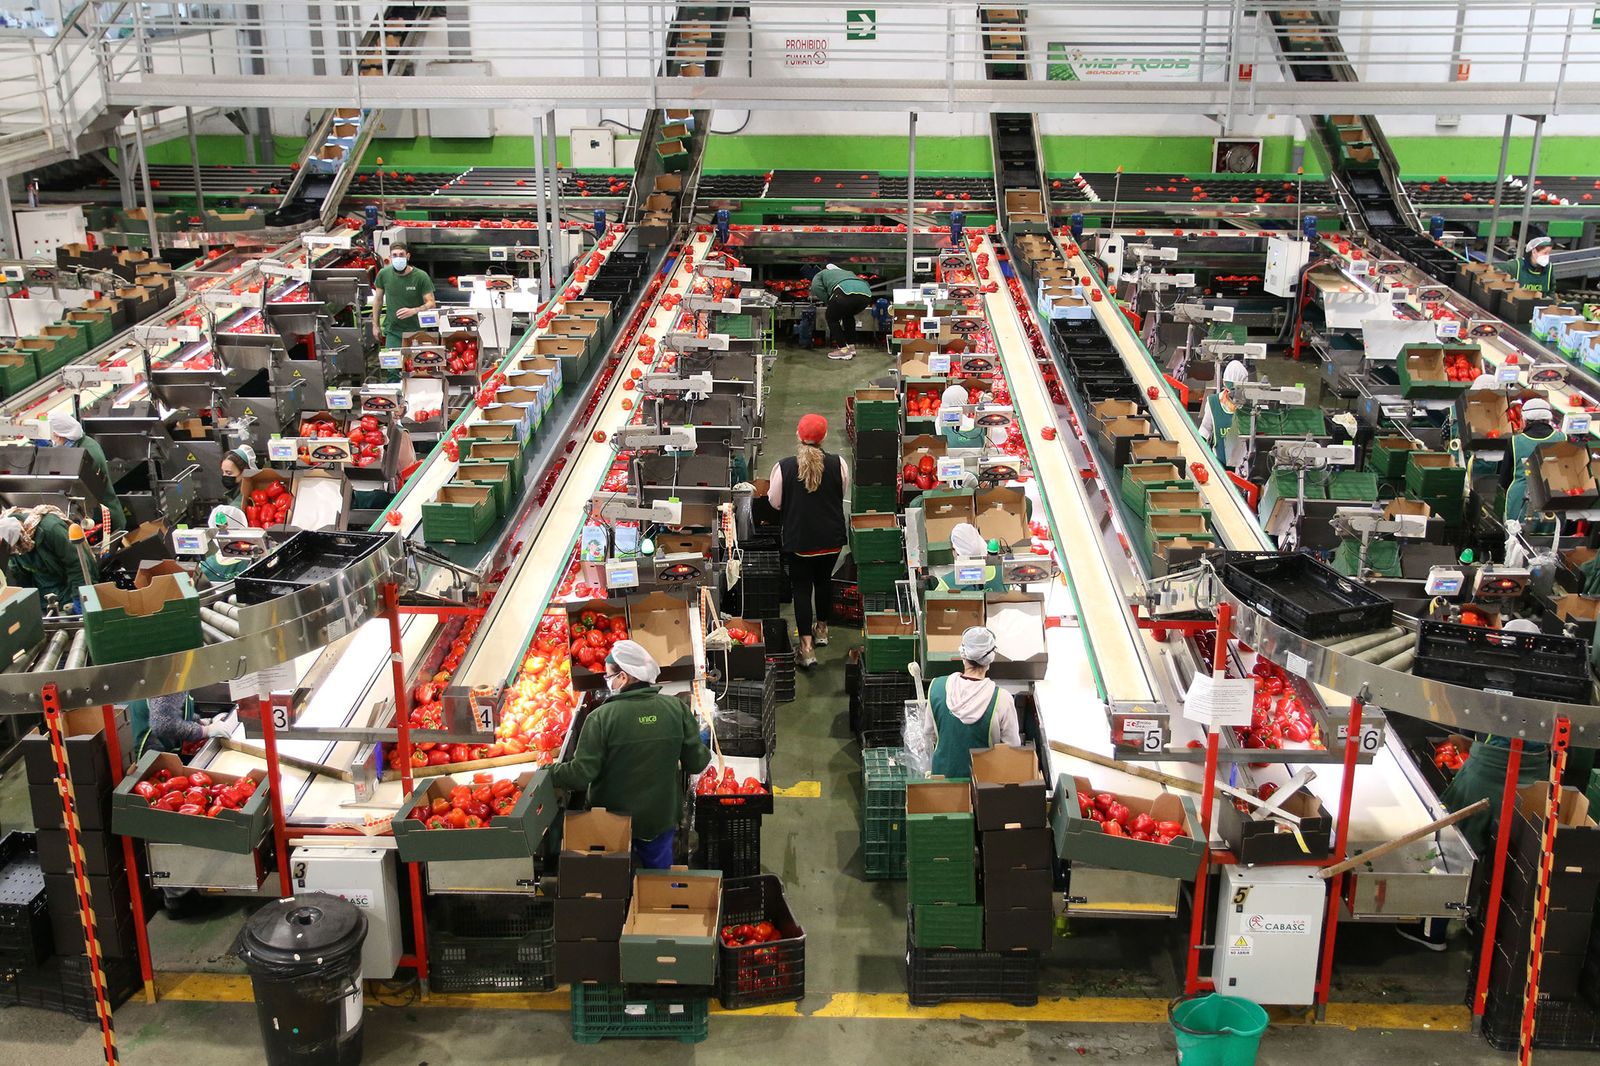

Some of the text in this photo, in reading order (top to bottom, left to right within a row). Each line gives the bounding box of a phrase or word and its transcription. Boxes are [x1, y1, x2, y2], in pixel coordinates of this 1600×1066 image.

[786, 39, 827, 50] PROHIBIDO
[273, 709, 287, 728] 3
[480, 709, 491, 728] 4
[1145, 730, 1160, 749] 5
[1363, 730, 1378, 750] 6
[295, 862, 306, 878] 3
[1233, 886, 1248, 904] 5
[1264, 923, 1305, 931] CABASC
